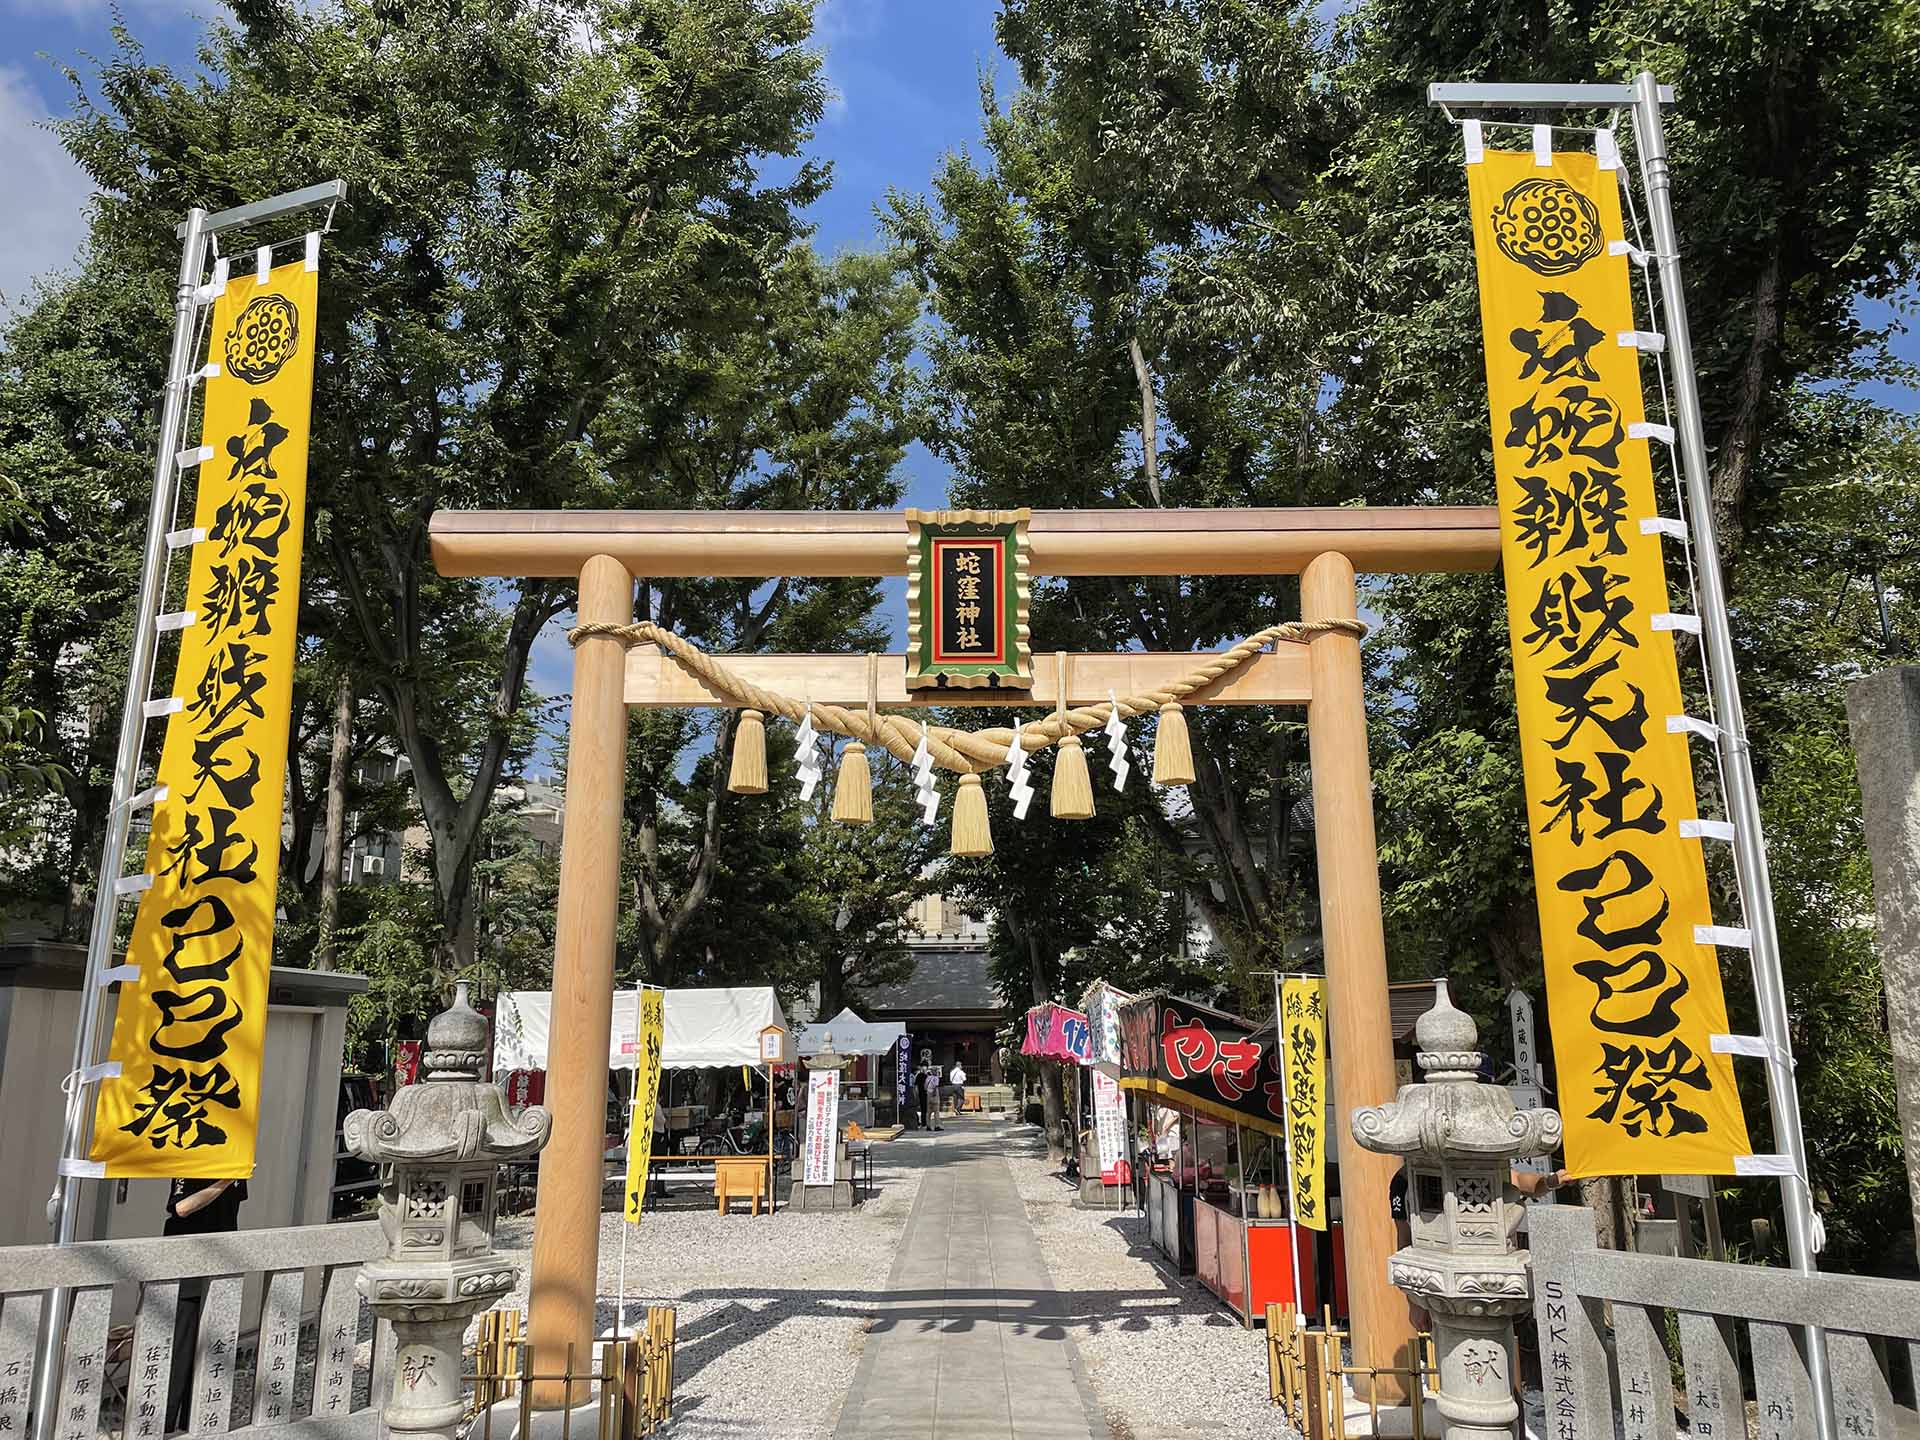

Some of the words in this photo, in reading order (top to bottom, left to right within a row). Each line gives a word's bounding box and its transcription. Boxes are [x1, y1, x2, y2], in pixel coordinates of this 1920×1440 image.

[955, 552, 982, 649] 蛇窪神社
[138, 1346, 161, 1437] 荏原不動産
[203, 1338, 227, 1428] 金子恒治
[327, 1324, 347, 1410] 木村尚子
[1545, 1280, 1578, 1440] SMK株式会社
[1766, 1400, 1784, 1440] 内
